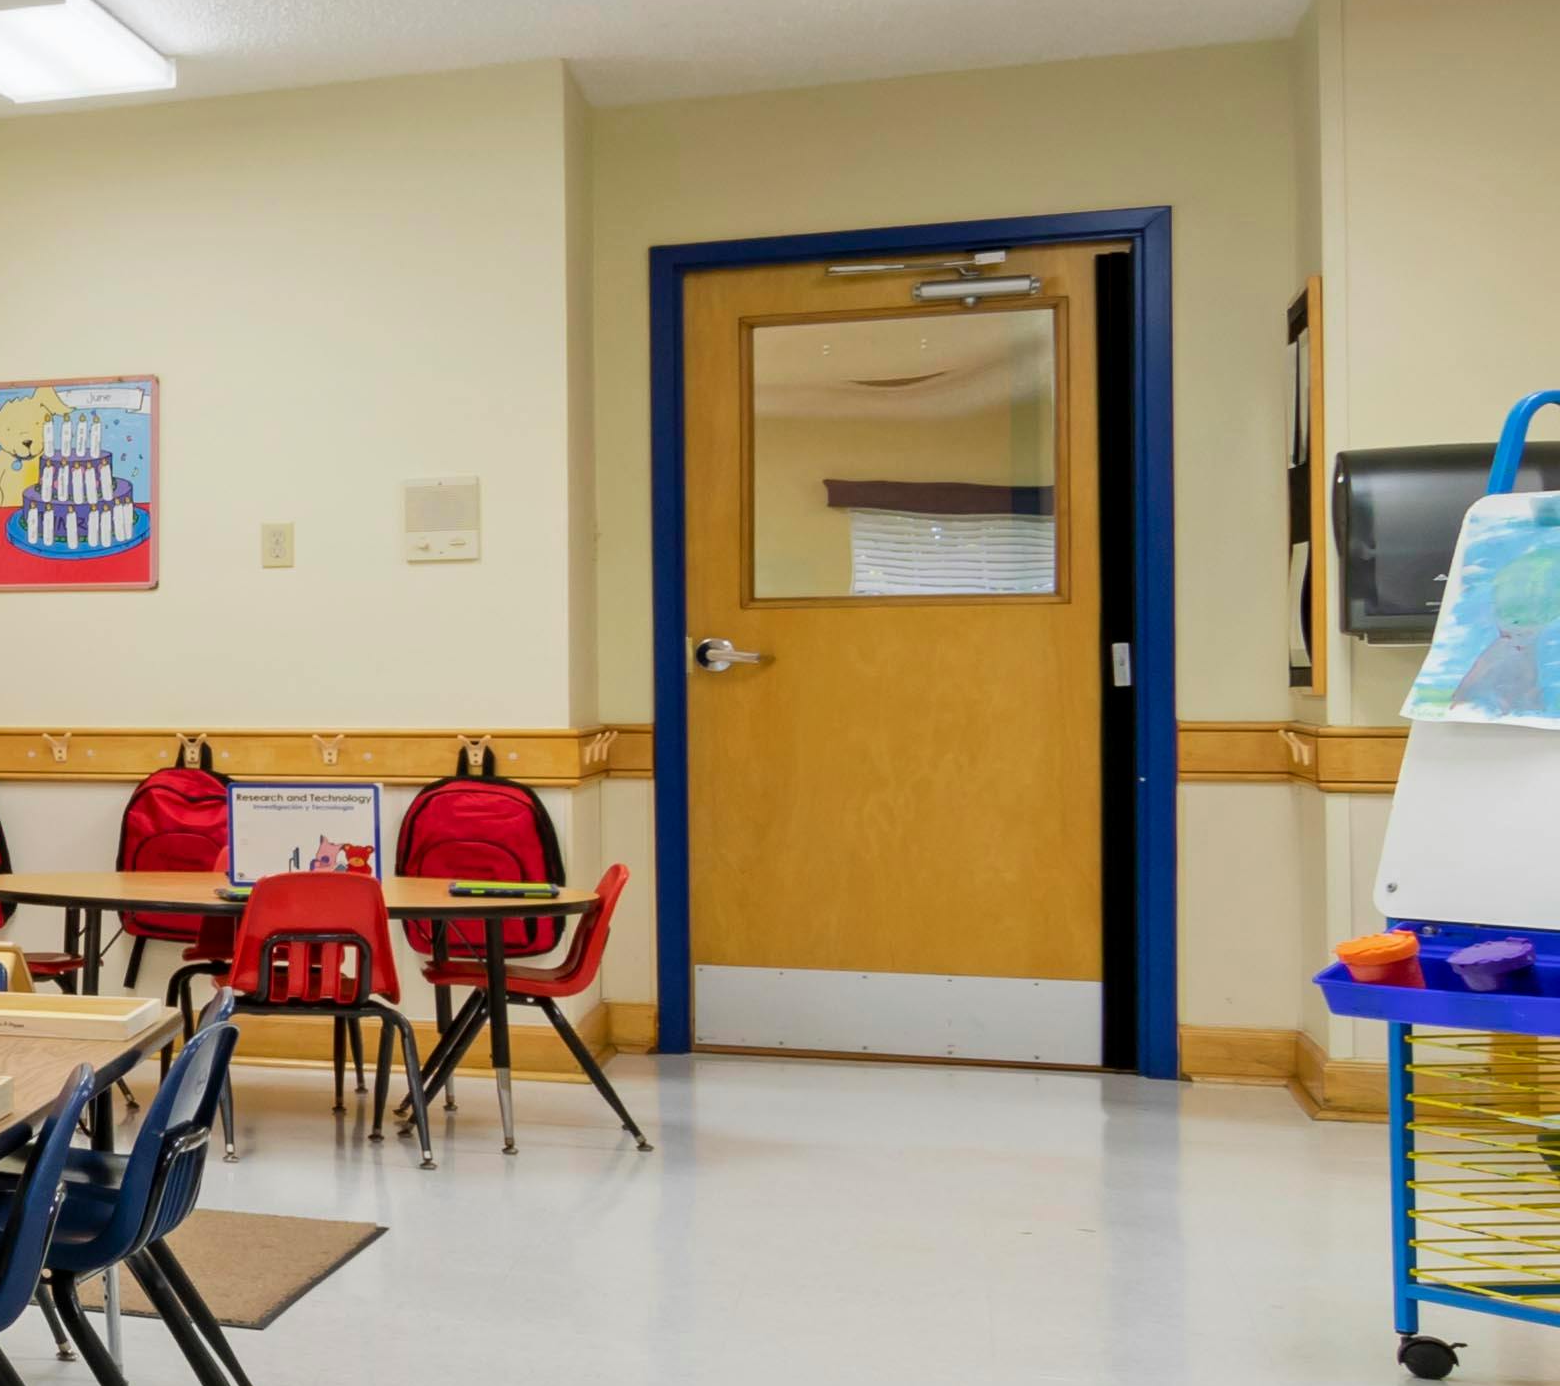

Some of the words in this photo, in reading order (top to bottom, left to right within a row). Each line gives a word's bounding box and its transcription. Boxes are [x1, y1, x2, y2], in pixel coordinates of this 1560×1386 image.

[87, 392, 112, 404] June
[236, 793, 283, 802] Research
[287, 793, 307, 802] and
[311, 794, 371, 804] Technology
